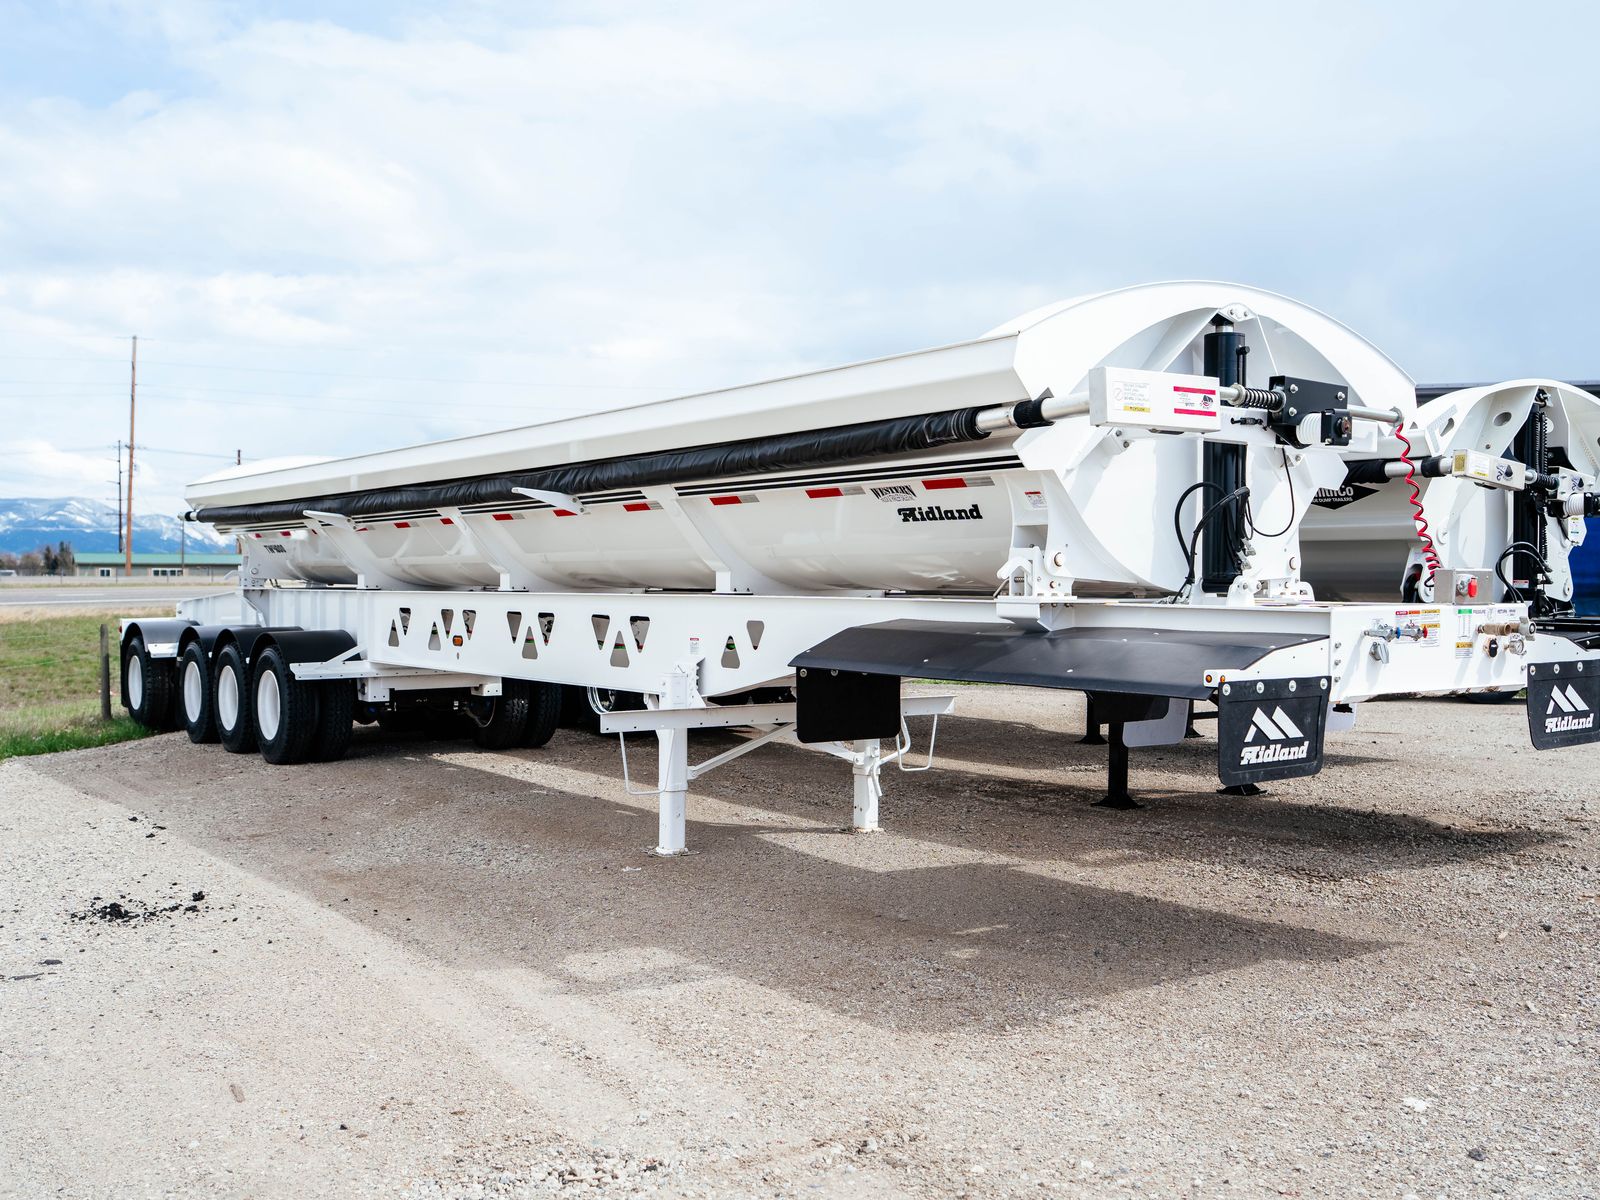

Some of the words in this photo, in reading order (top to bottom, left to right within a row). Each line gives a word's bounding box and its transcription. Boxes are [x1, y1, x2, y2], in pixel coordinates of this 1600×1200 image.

[870, 484, 917, 500] WESTERN
[897, 504, 983, 523] Midland
[1545, 713, 1594, 733] Midland
[1240, 740, 1309, 765] Midland
